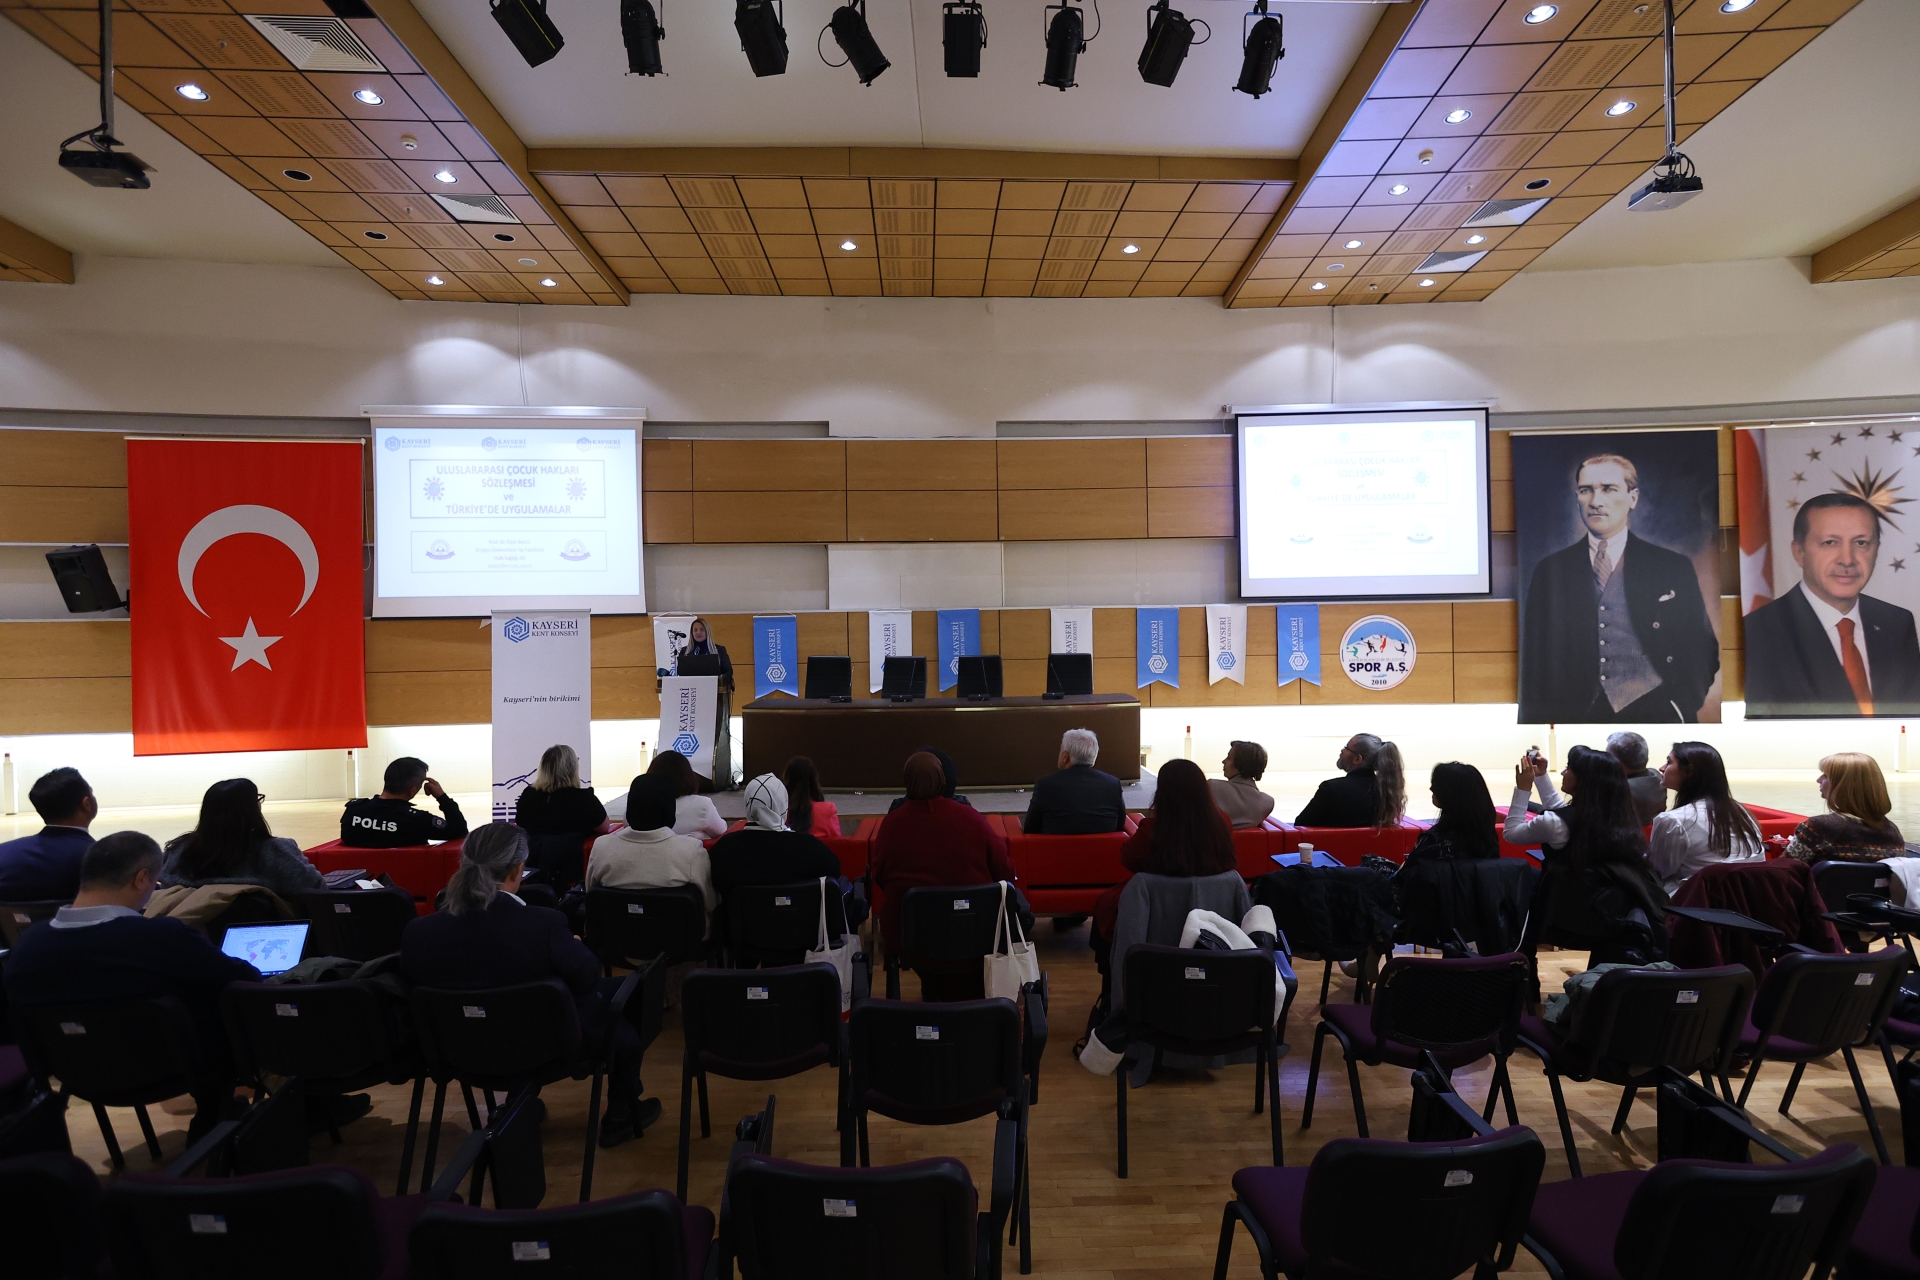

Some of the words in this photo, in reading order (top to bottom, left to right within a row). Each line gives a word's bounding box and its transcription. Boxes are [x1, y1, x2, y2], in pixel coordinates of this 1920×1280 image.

[436, 465, 504, 475] ULUSLARARASI
[506, 465, 538, 476] ÇOCUK
[540, 465, 579, 475] HAKLARI
[481, 476, 536, 489] SÖZLEŞMESİ
[503, 492, 514, 501] ve
[501, 504, 572, 514] UYGULAMALAR
[531, 618, 579, 630] KAYSERİ
[951, 621, 960, 655] KAYSERİ
[1150, 620, 1158, 654] KAYSERİ
[1290, 617, 1298, 651] KAYSERİ
[767, 628, 776, 663] KAYSERİ
[1349, 662, 1381, 672] SPOR
[1386, 662, 1408, 674] A.Ş.
[503, 695, 547, 704] Kayseri'nin
[549, 694, 580, 702] birikimi
[679, 687, 689, 732] KAYSERİ
